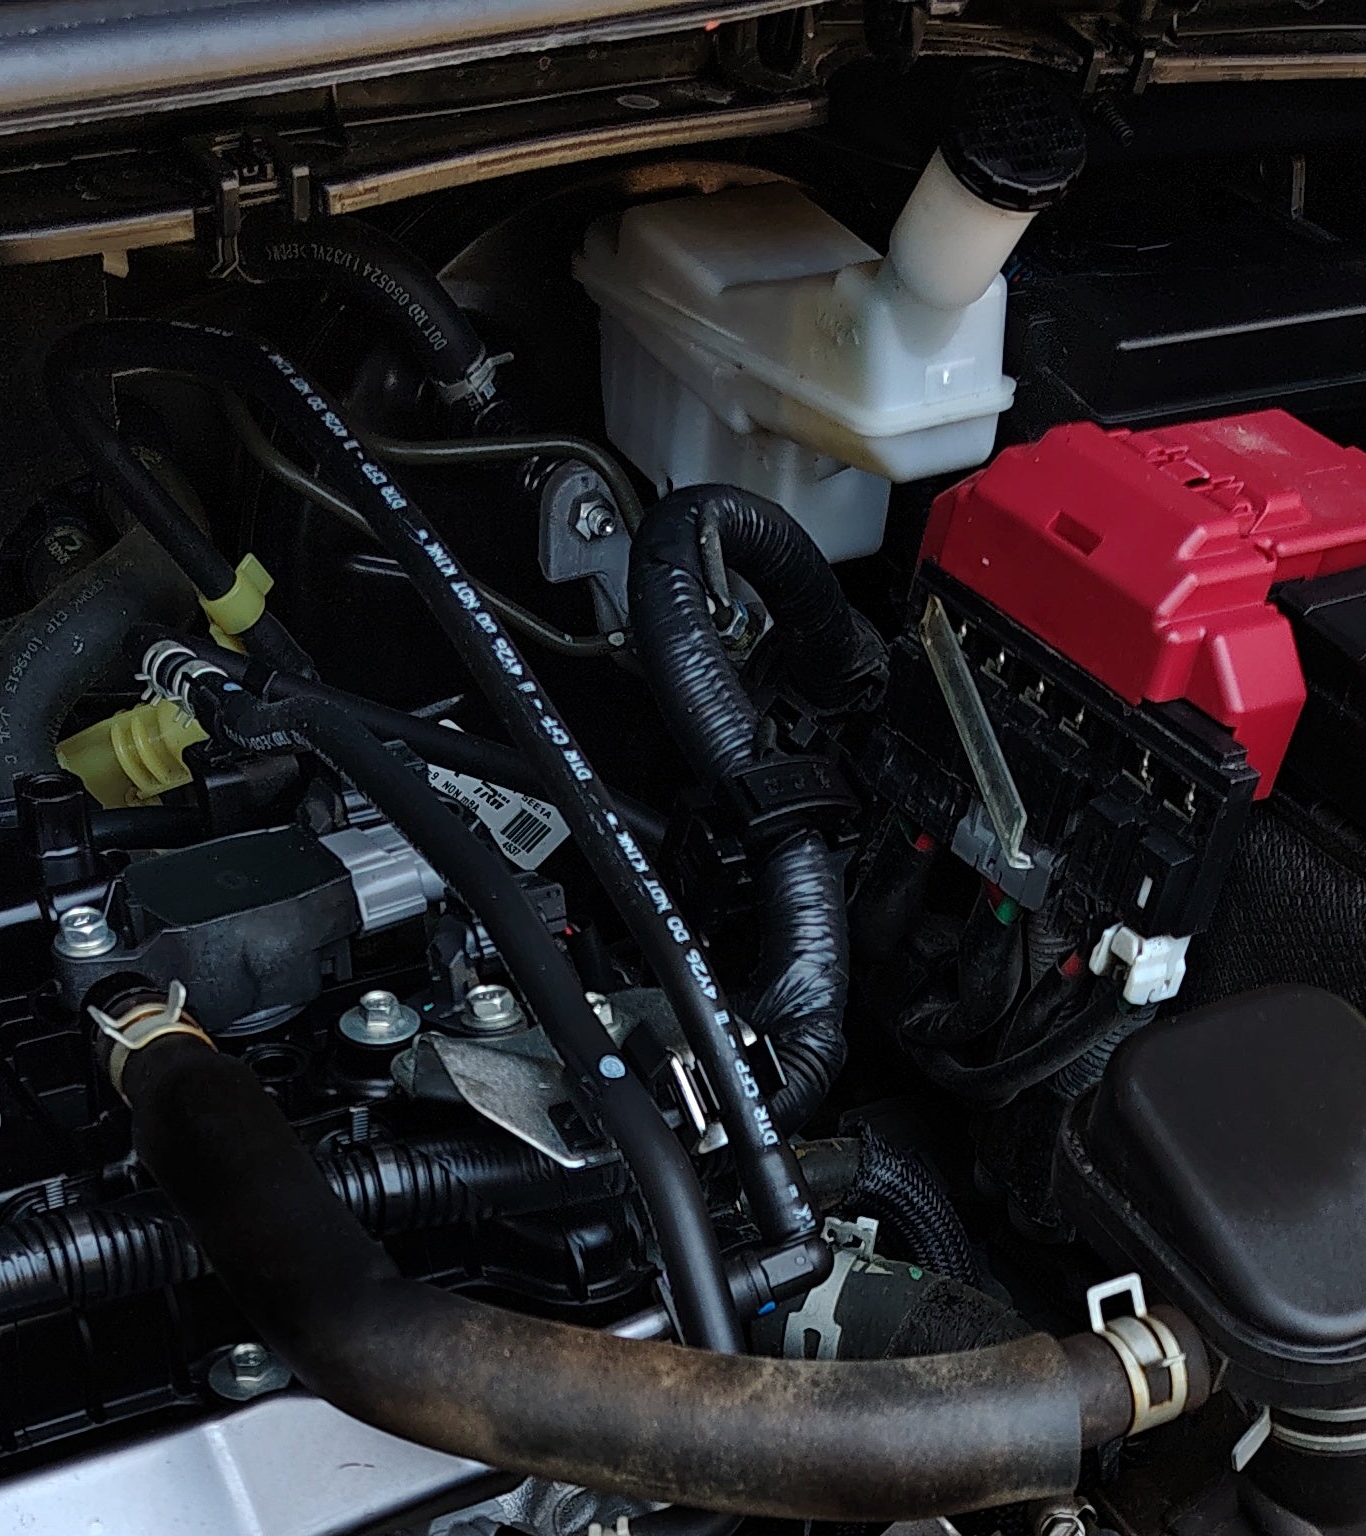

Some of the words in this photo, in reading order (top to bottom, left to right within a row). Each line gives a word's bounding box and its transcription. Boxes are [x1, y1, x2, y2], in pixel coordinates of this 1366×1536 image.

[363, 262, 409, 306] 050524
[424, 542, 458, 575] KINK
[449, 579, 481, 609] NOT
[442, 780, 461, 796] NON
[502, 841, 522, 856] 4537
[643, 879, 673, 913] NOT
[665, 917, 690, 942] DO
[683, 950, 718, 998] 4Y26
[752, 1106, 780, 1146] DTR
